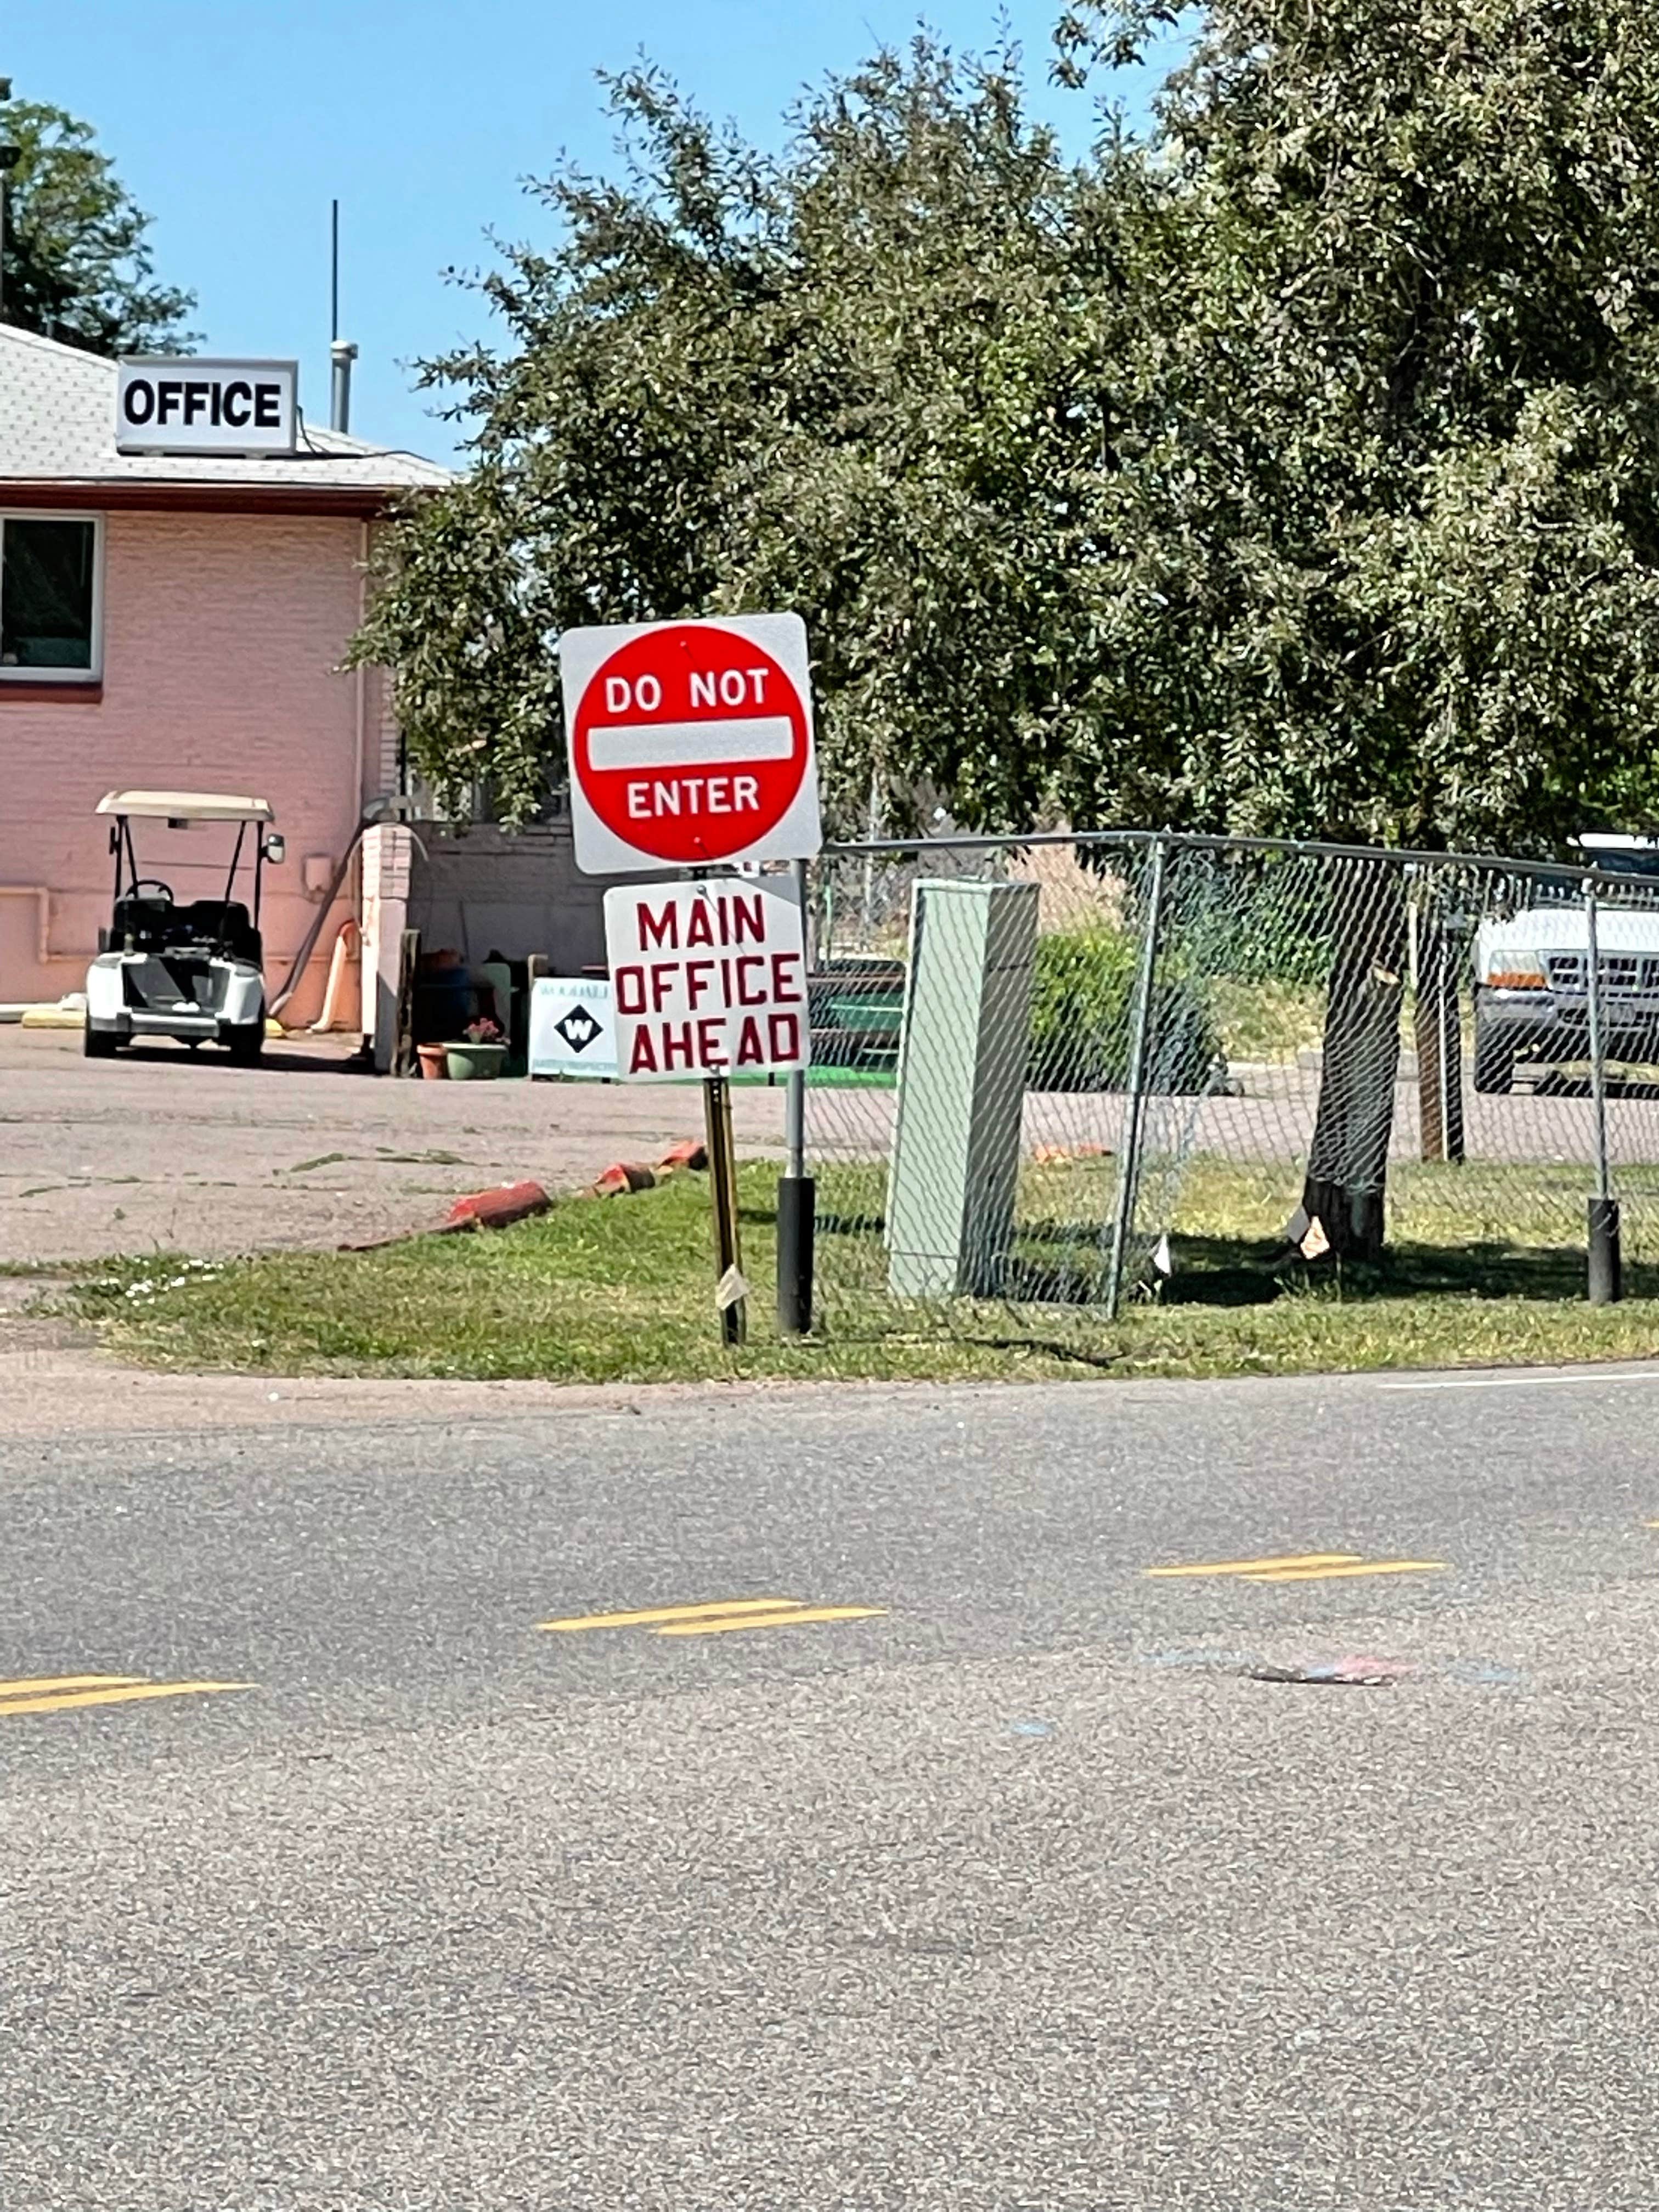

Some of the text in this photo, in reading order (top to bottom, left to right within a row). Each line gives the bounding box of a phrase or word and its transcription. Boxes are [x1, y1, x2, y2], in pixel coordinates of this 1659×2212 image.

[125, 379, 281, 427] OFFICE
[606, 669, 769, 713] DO NOT
[628, 776, 760, 819] ENTER
[636, 894, 765, 951] MAIN
[615, 953, 802, 1015] OFFICE
[564, 1019, 592, 1041] W
[629, 1013, 800, 1074] AHEAD
